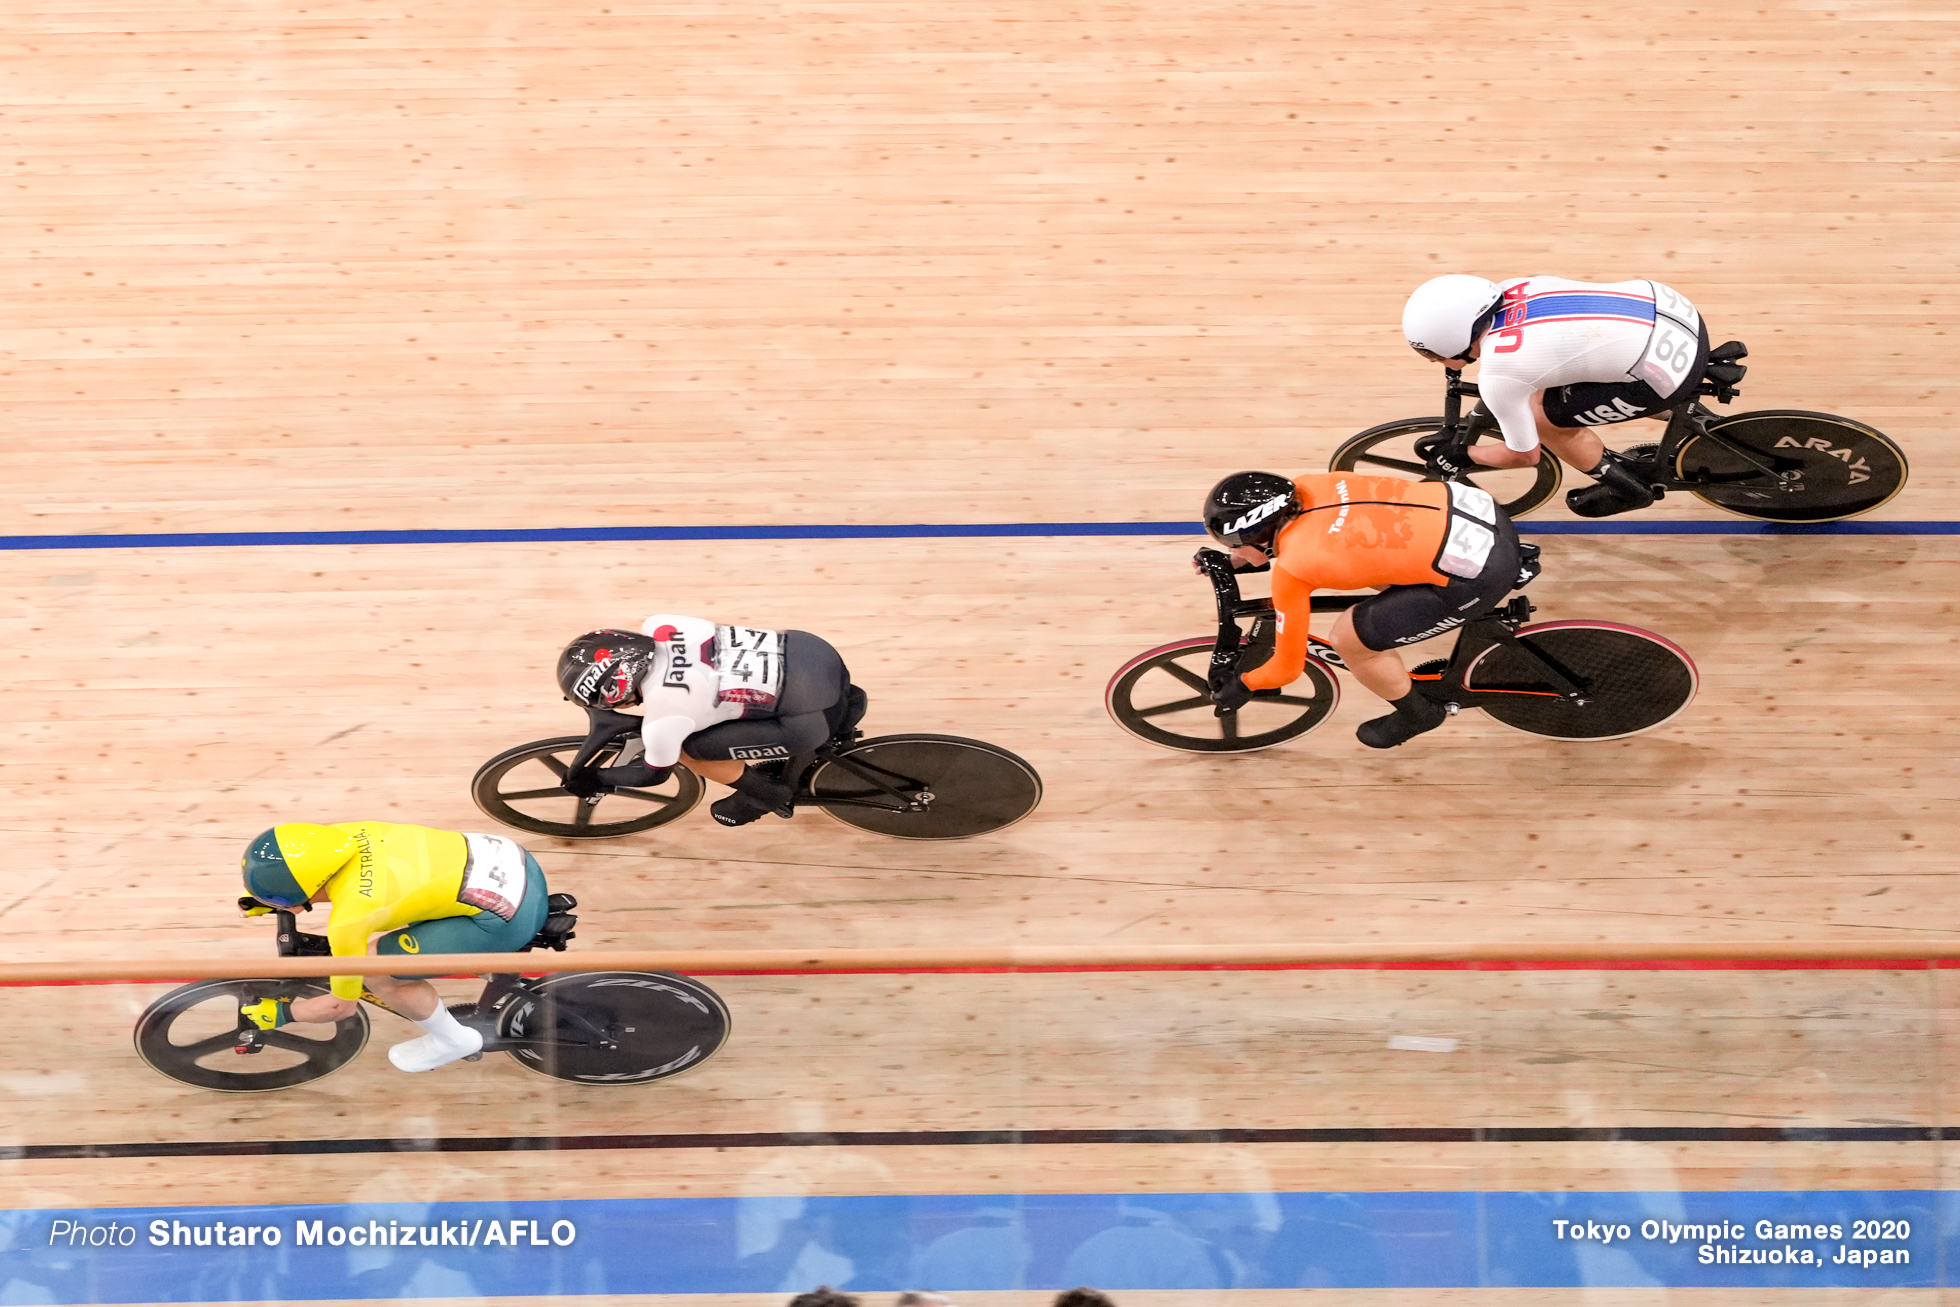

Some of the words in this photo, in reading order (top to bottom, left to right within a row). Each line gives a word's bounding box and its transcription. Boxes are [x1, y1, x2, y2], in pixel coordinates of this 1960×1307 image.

[1494, 281, 1530, 353] USA
[1655, 329, 1689, 373] 66
[1573, 397, 1648, 426] USA
[1436, 455, 1459, 473] USA
[1774, 436, 1872, 485] ARAYA
[1223, 493, 1288, 535] LAZER
[1328, 480, 1350, 534] TeamNL
[1452, 522, 1492, 554] 47
[1394, 616, 1466, 644] TeamNL
[573, 658, 612, 706] Japan
[662, 631, 693, 695] Japan
[730, 648, 769, 684] 41
[353, 831, 373, 898] AUSTRALIA
